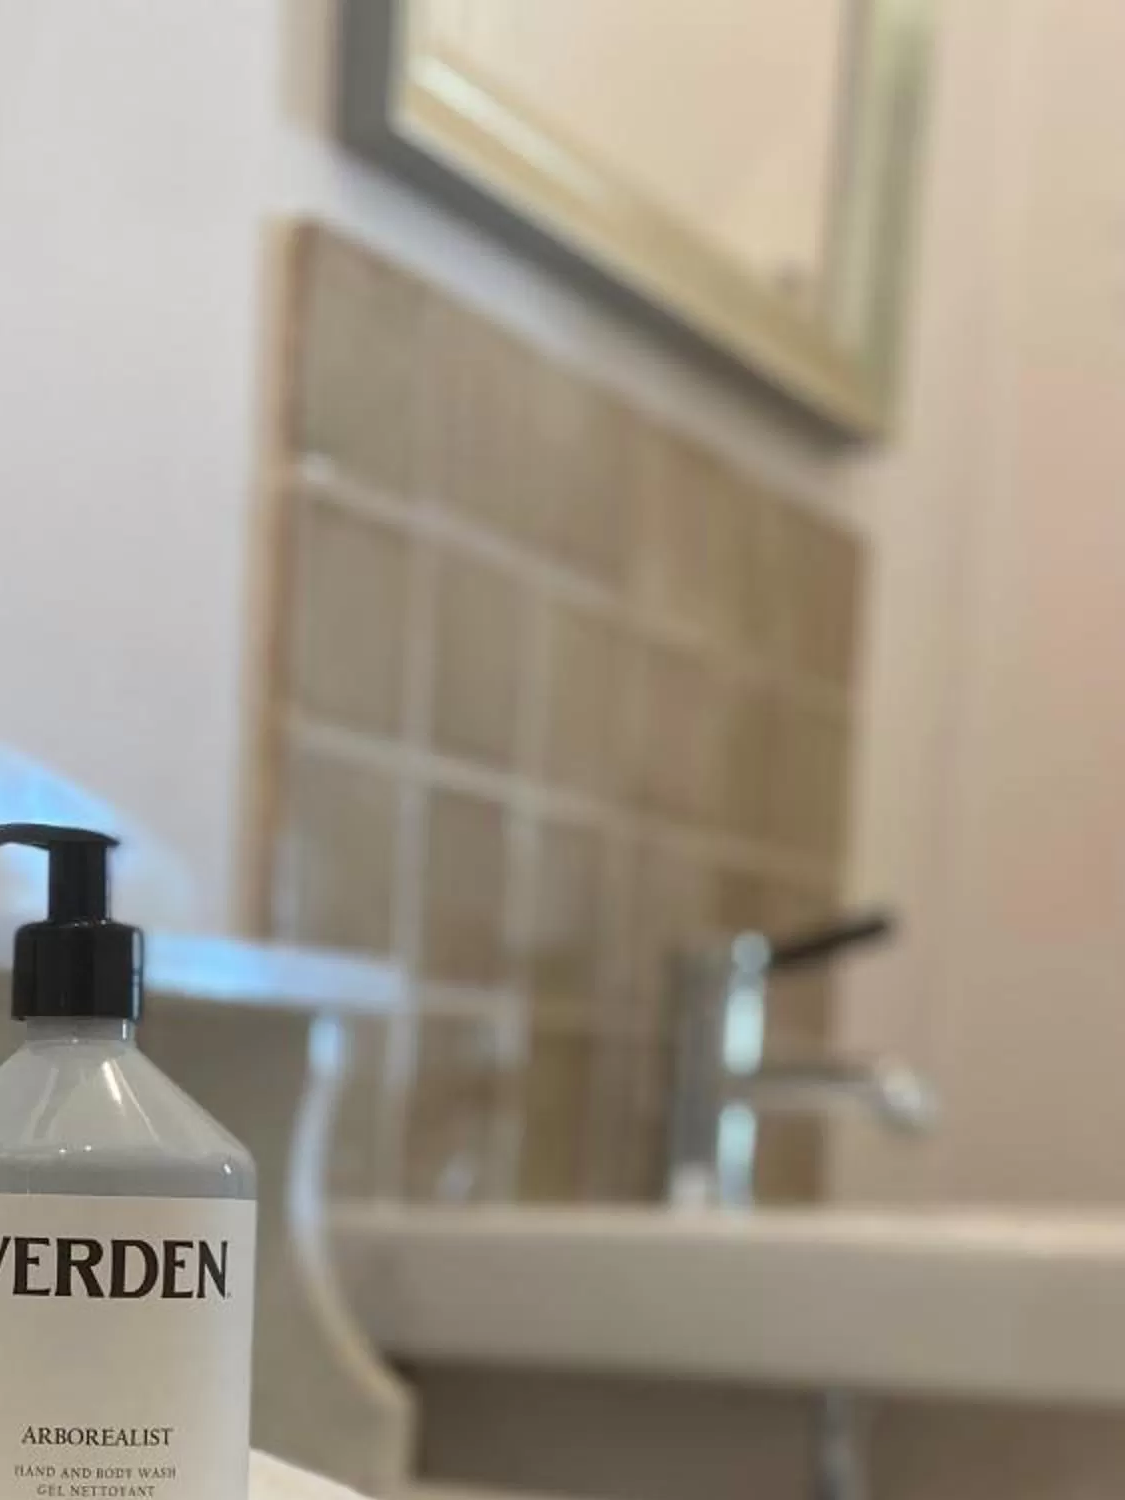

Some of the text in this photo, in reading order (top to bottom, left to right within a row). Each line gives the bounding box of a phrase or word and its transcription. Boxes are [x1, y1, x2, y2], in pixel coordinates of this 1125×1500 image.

[21, 1425, 173, 1447] ARBOREALIST
[14, 1464, 177, 1480] HAND AND BODY WASH
[36, 1484, 156, 1497] GEL NETTOYANT
